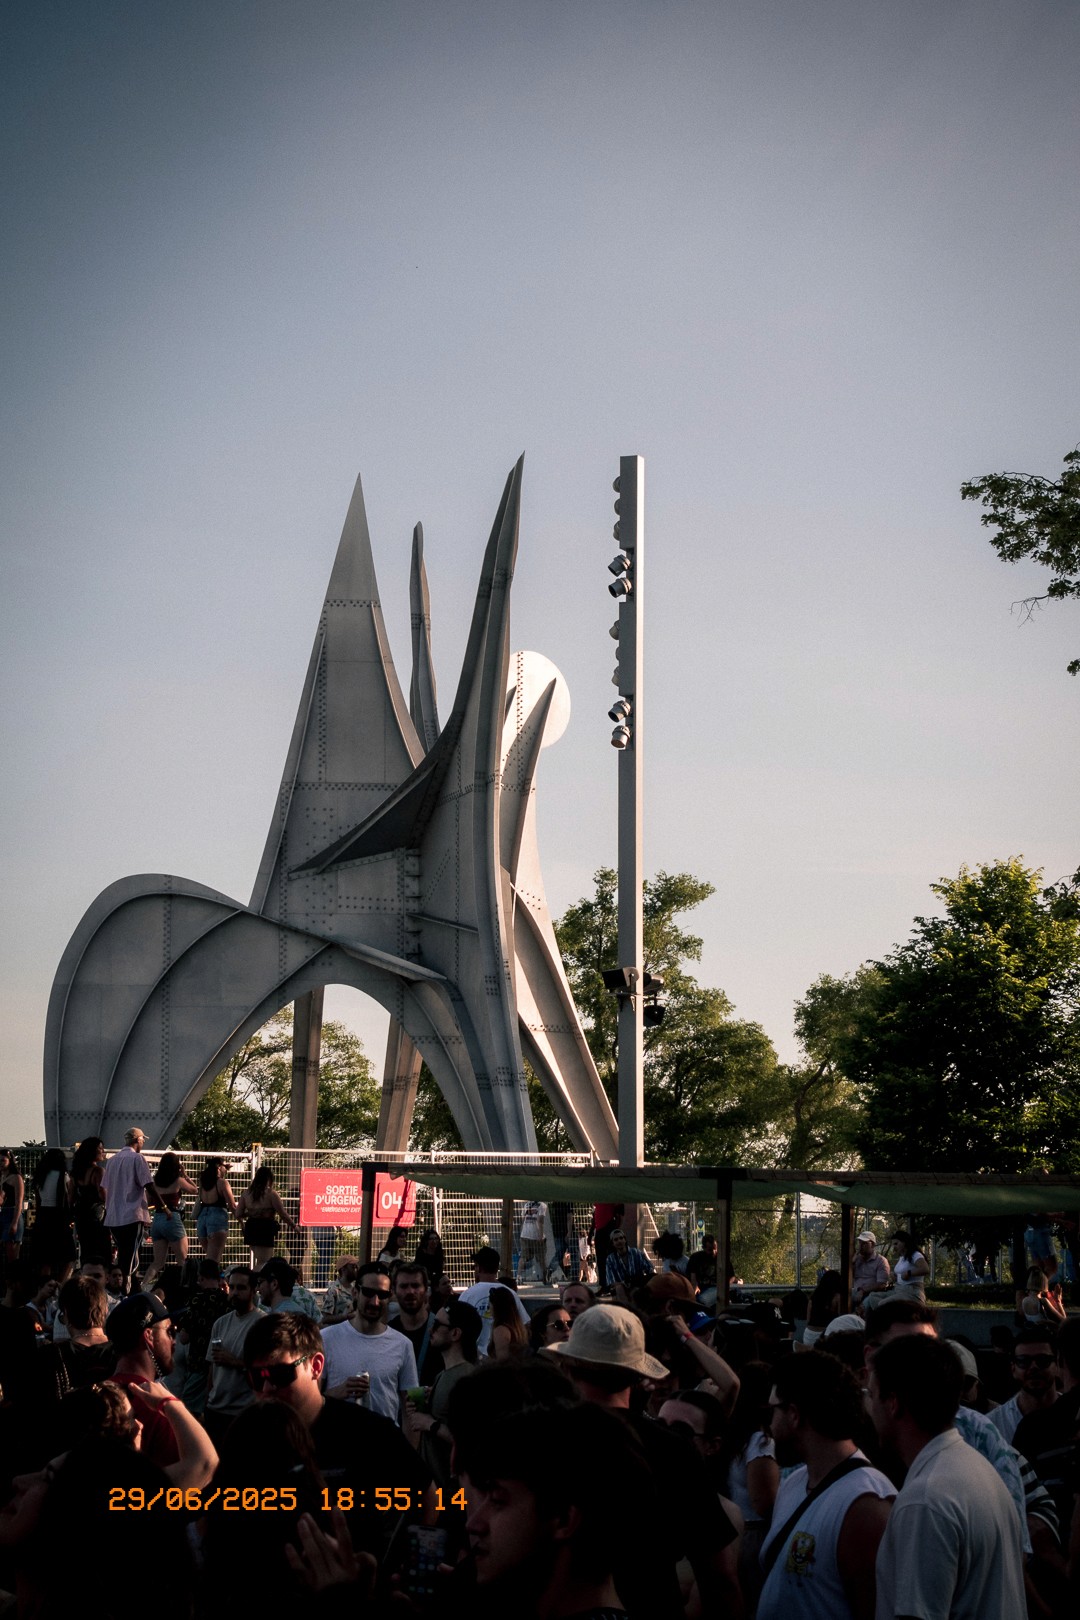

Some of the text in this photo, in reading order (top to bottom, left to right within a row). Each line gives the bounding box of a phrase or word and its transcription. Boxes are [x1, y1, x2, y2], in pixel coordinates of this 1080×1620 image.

[326, 1185, 358, 1195] SORTIE
[315, 1195, 362, 1205] D'URGENC
[381, 1191, 403, 1209] 04
